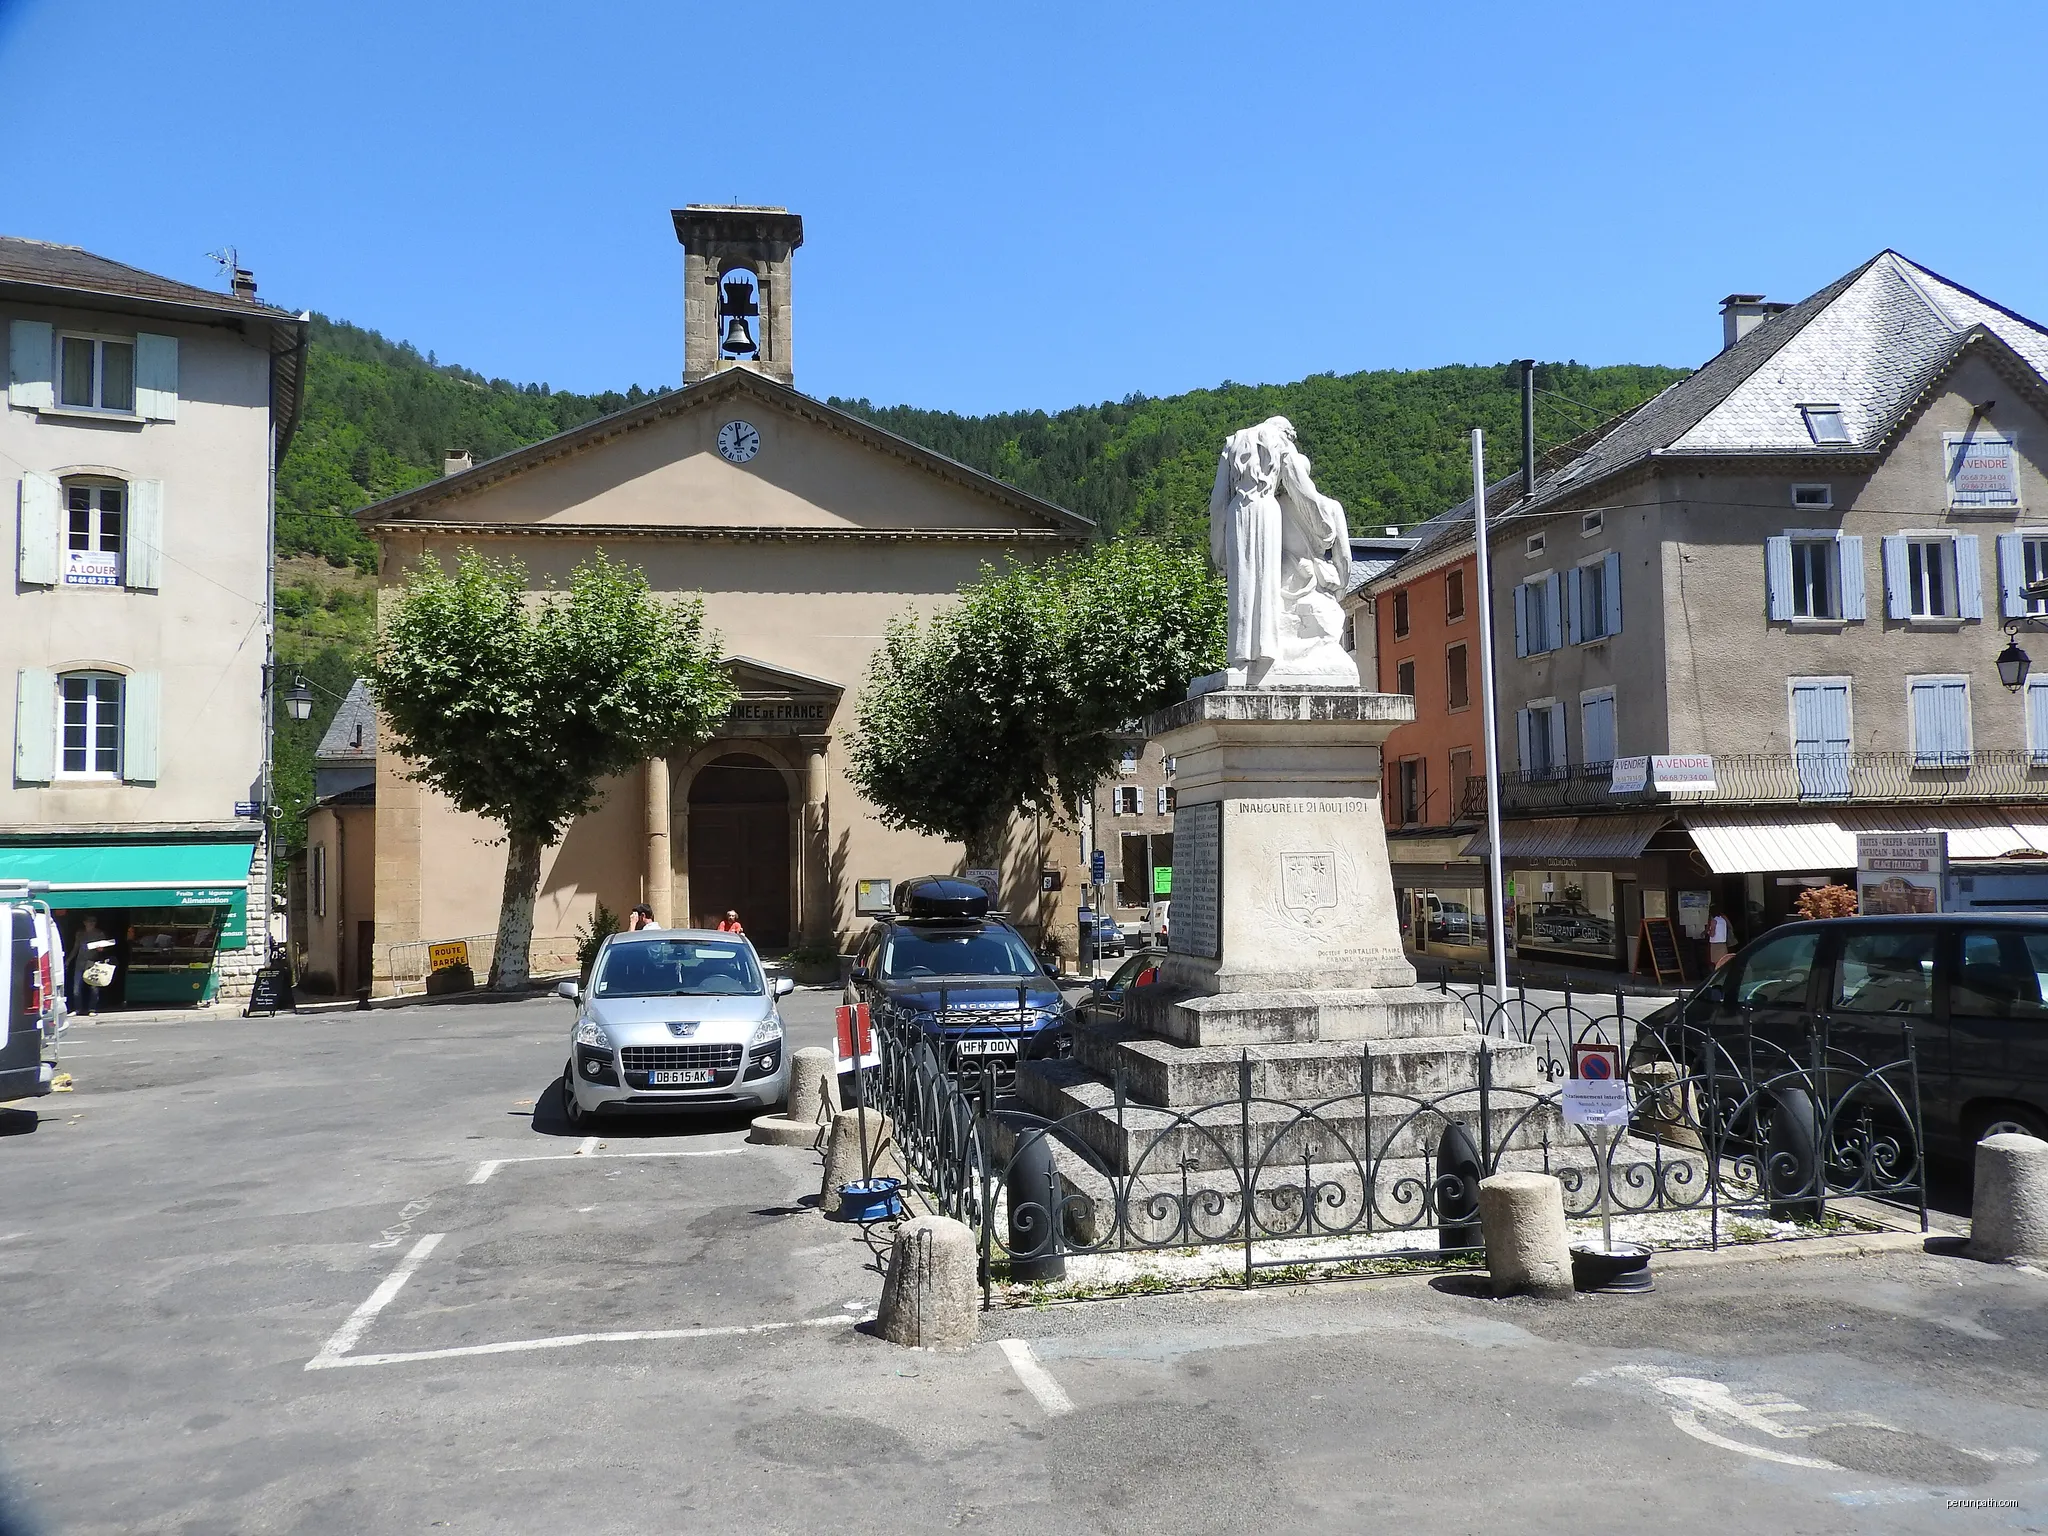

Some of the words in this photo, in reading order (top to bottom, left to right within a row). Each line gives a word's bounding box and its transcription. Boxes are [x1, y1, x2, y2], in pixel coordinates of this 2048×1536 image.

[1967, 460, 2008, 469] VENDRE
[69, 565, 78, 573] A
[81, 566, 117, 575] LOUER
[763, 709, 775, 719] DE
[777, 705, 824, 719] FRANCE
[1621, 758, 1646, 770] VENDRE
[1656, 760, 1664, 768] A
[1667, 758, 1709, 768] VENDRE
[1294, 803, 1304, 813] LE
[1306, 802, 1317, 813] 21
[1345, 801, 1368, 813] 1921
[1534, 923, 1576, 937] RESTAURANT
[1581, 927, 1601, 940] GRILL
[435, 946, 462, 957] ROUTE
[947, 1002, 1019, 1010] DISCOVER
